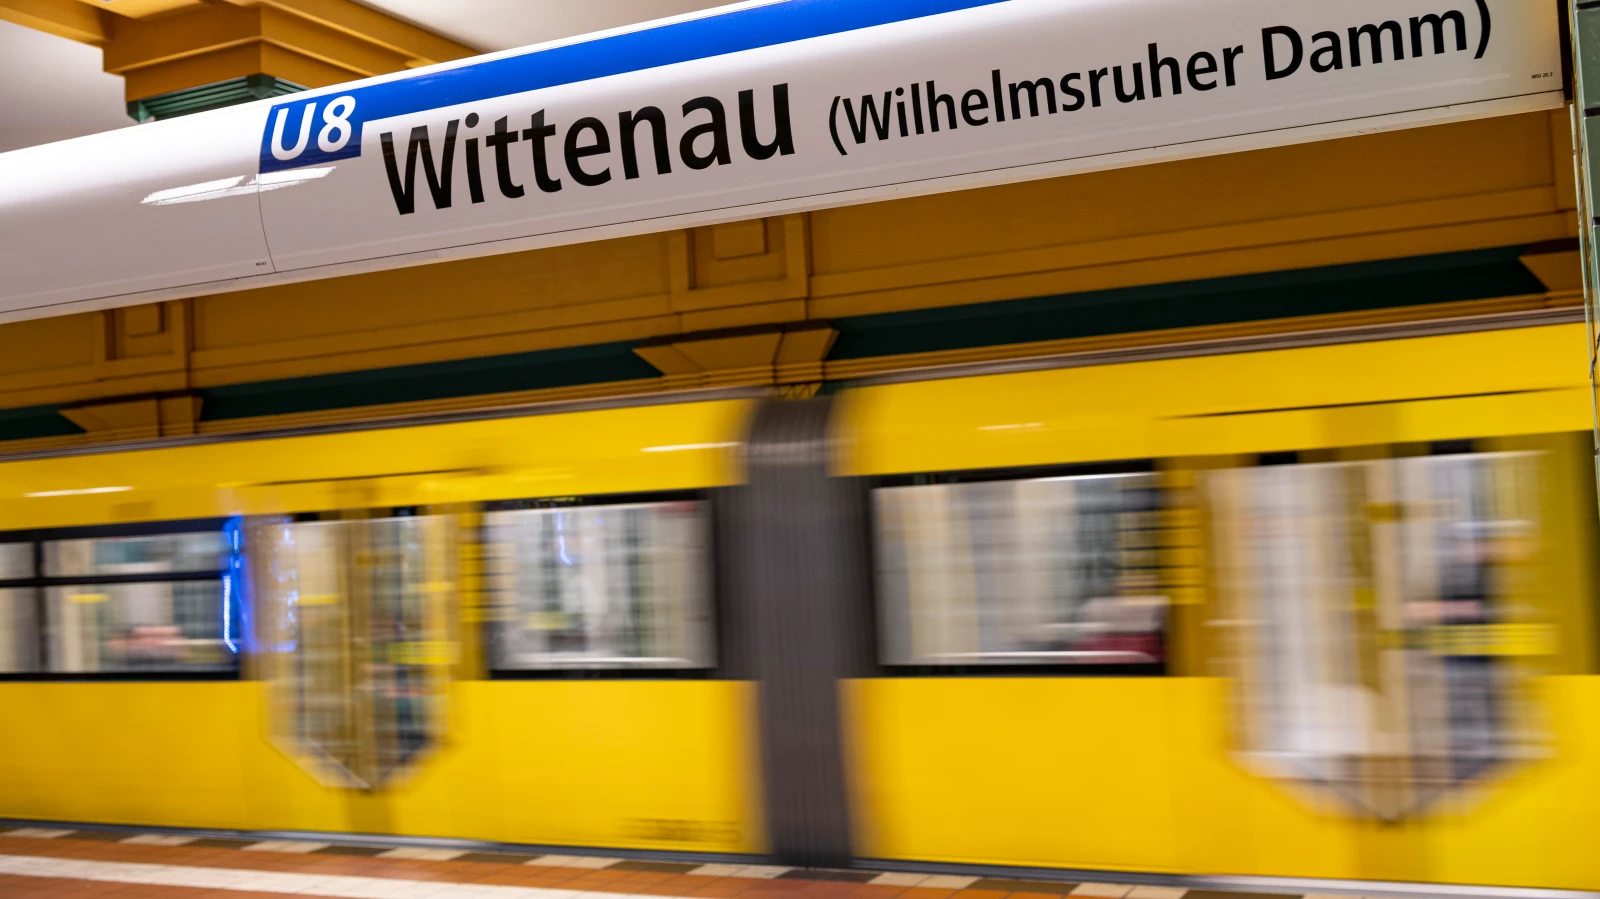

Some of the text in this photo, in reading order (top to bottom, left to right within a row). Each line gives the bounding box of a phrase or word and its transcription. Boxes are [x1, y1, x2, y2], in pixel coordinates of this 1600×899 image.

[270, 95, 356, 161] U8
[380, 0, 1492, 216] Wittenau (Wilhelmsruher Damm)
